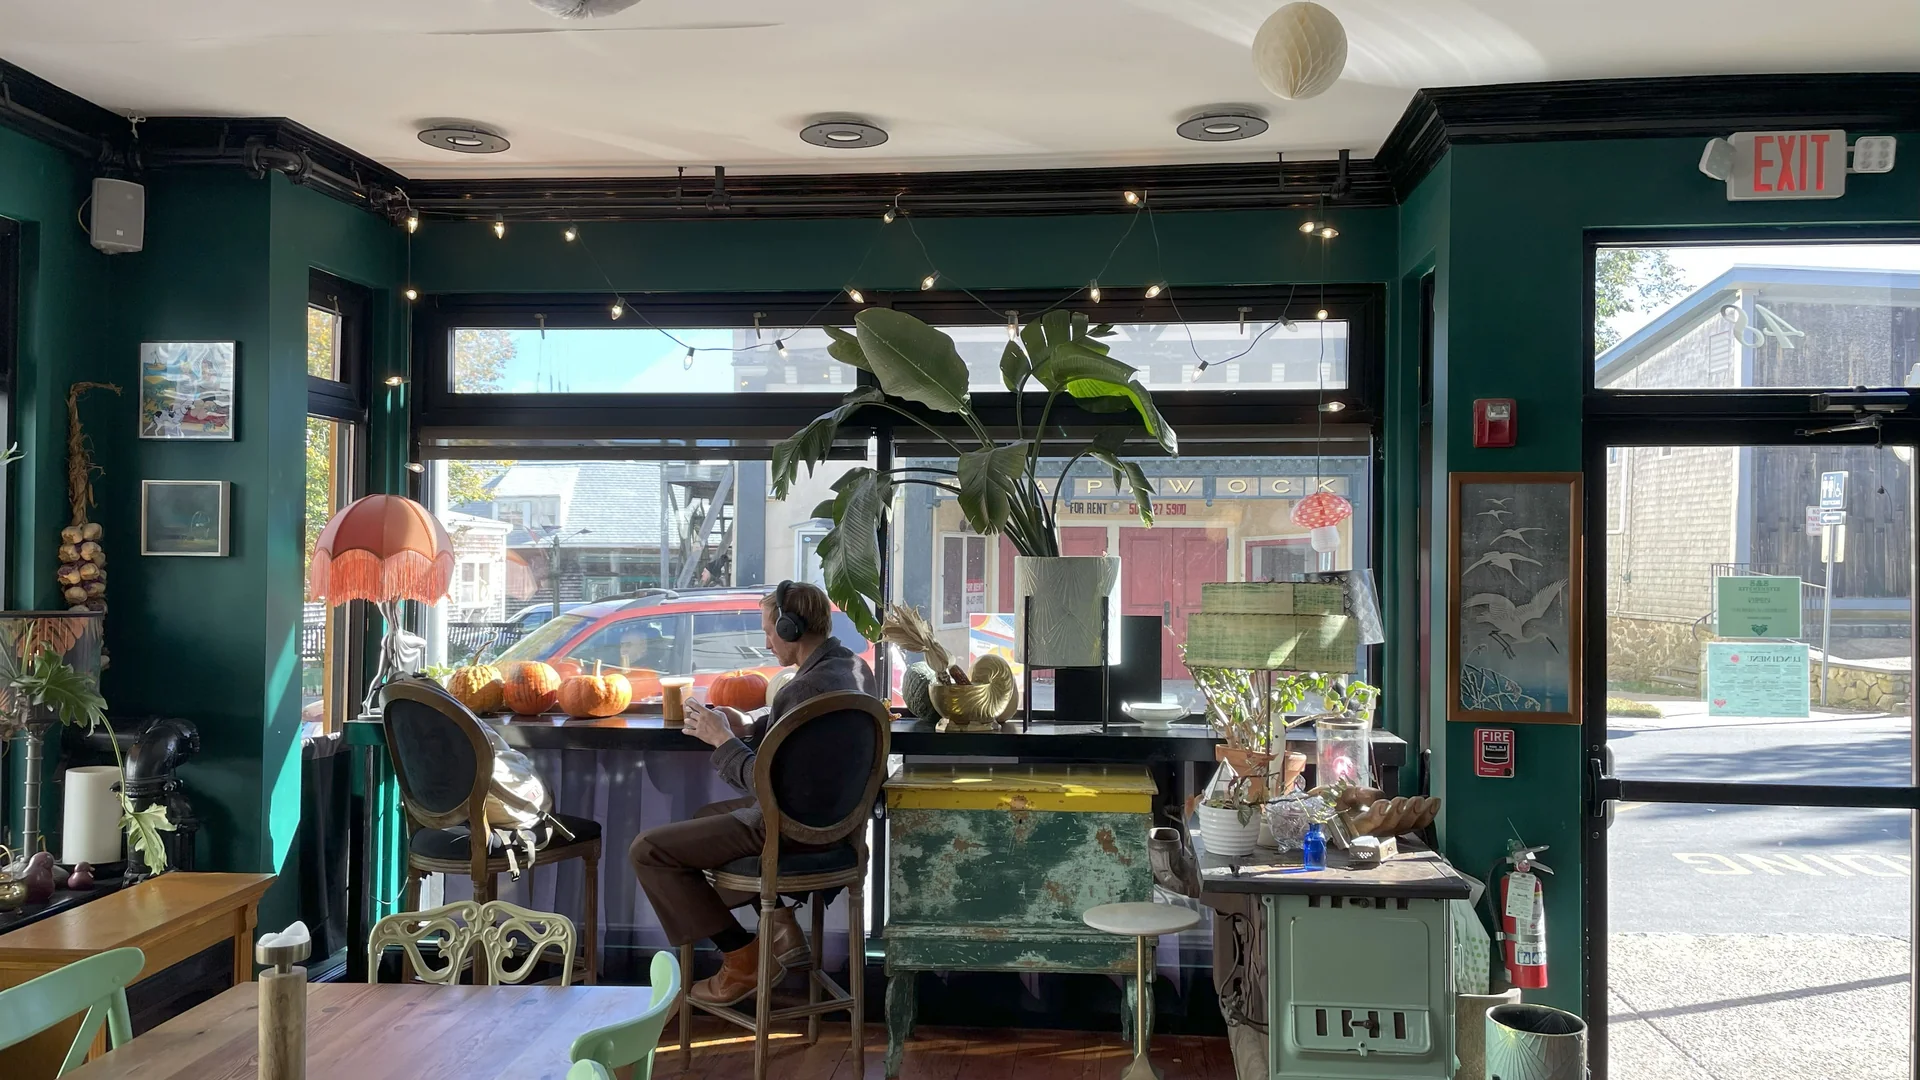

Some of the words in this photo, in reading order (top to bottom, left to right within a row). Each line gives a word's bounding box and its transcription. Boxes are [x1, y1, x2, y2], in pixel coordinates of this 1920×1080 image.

[1753, 134, 1830, 192] EXIT
[1069, 502, 1083, 514] FOR
[1086, 502, 1107, 515] RENT
[1166, 503, 1187, 515] 5900
[1482, 731, 1510, 742] FIRE
[1672, 852, 1911, 877] DING
